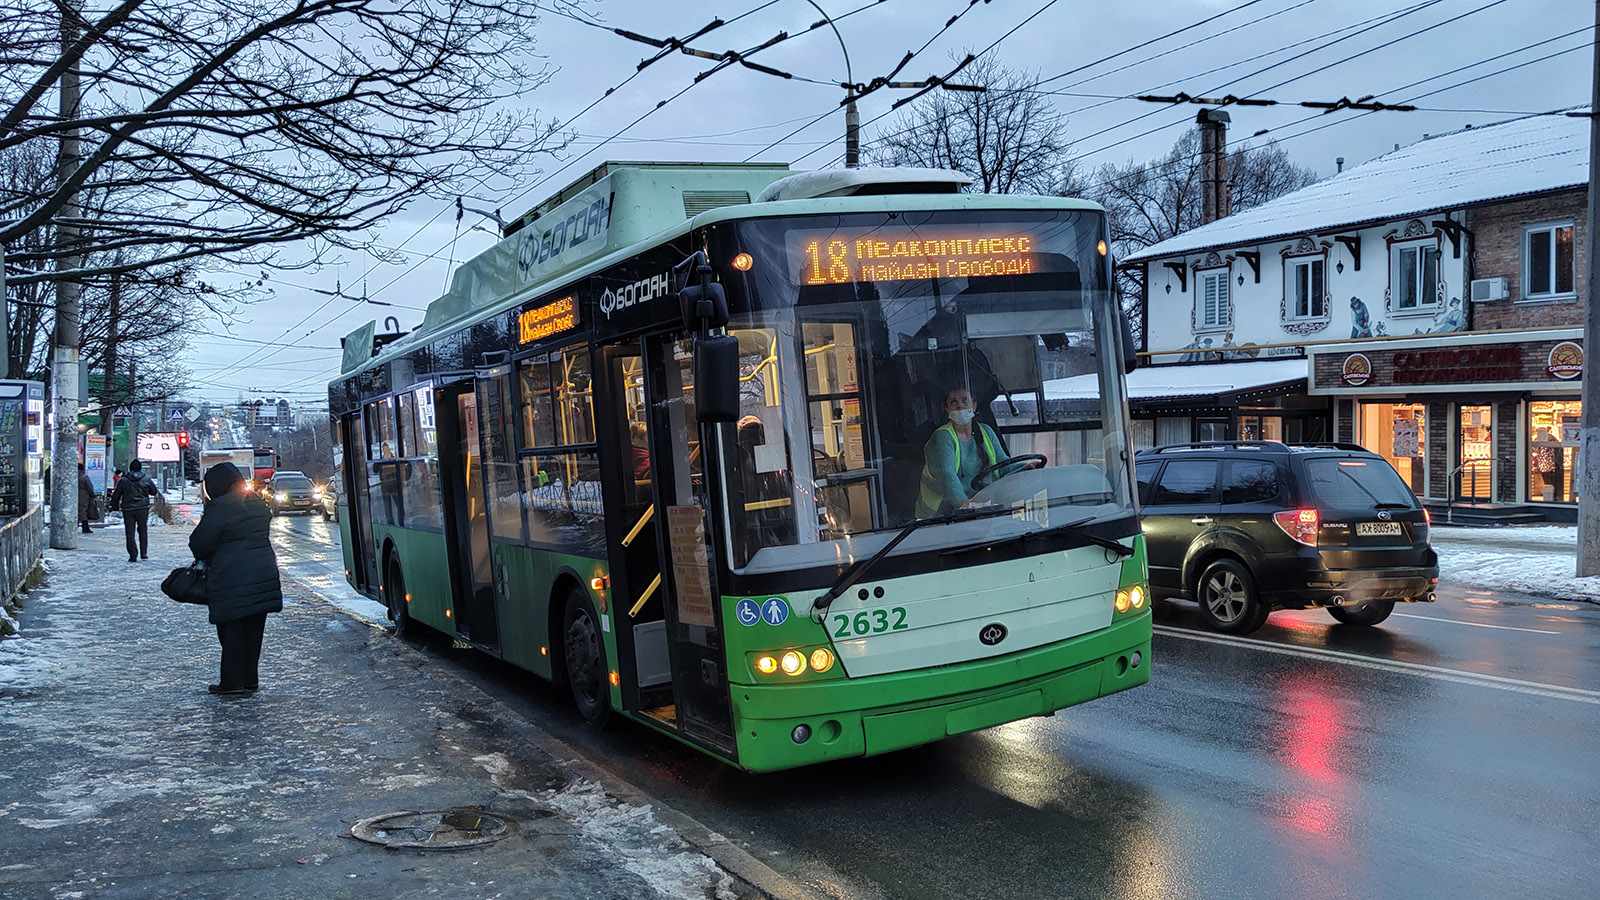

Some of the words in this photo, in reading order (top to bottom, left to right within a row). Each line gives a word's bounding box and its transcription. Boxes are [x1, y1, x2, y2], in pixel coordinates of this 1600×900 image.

[538, 197, 610, 265] БОГДАН
[805, 240, 849, 284] 18
[856, 236, 1031, 259] Медкомплекс
[946, 257, 1032, 278] Свободи
[616, 271, 669, 309] БОГДАН
[518, 311, 531, 344] 18
[833, 606, 909, 638] 2632
